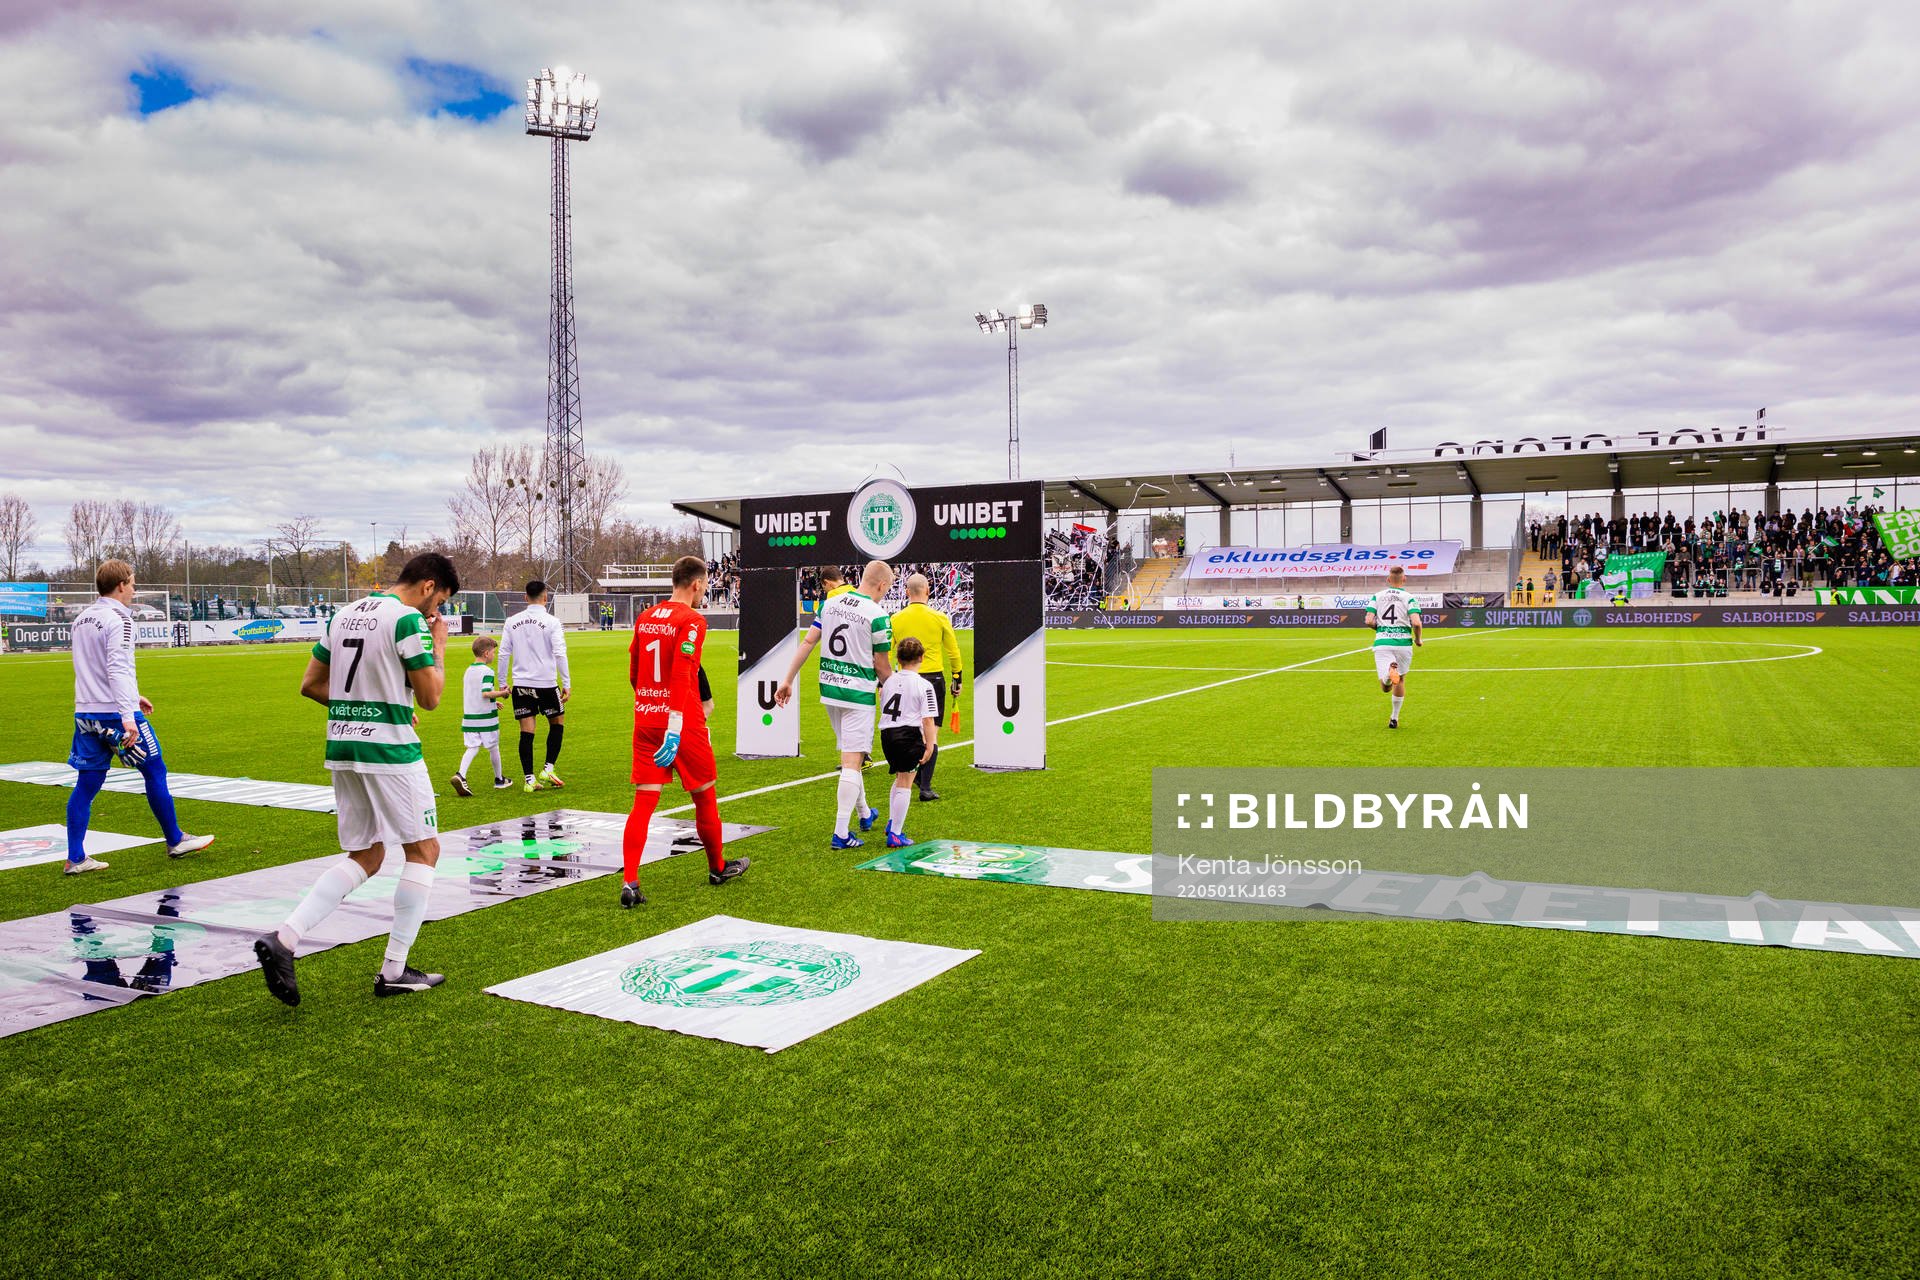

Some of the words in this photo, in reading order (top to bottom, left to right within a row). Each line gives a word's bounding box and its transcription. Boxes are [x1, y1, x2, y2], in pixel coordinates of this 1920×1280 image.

[934, 500, 1023, 526] UNIBET
[755, 511, 830, 534] UNIBET
[1208, 548, 1435, 563] eklundsglas.se
[840, 597, 860, 607] ABB
[651, 608, 673, 618] ABB
[1093, 615, 1157, 625] SALBOHEDS
[1178, 615, 1246, 625] SALBOHEDS
[1270, 614, 1340, 625] SALBOHEDS
[1382, 604, 1398, 624] 4
[1485, 610, 1563, 626] SUPERETTAN
[1606, 613, 1692, 624] SALBOHEDS
[1722, 612, 1815, 623] SALBOHEDS
[15, 628, 39, 642] One
[41, 627, 55, 642] of
[57, 627, 71, 642] th
[140, 627, 168, 638] BELLE
[829, 624, 849, 657] 6
[342, 638, 364, 694] 7
[645, 639, 661, 682] 1
[758, 681, 778, 710] U
[997, 685, 1020, 718] U
[883, 693, 902, 722] 4
